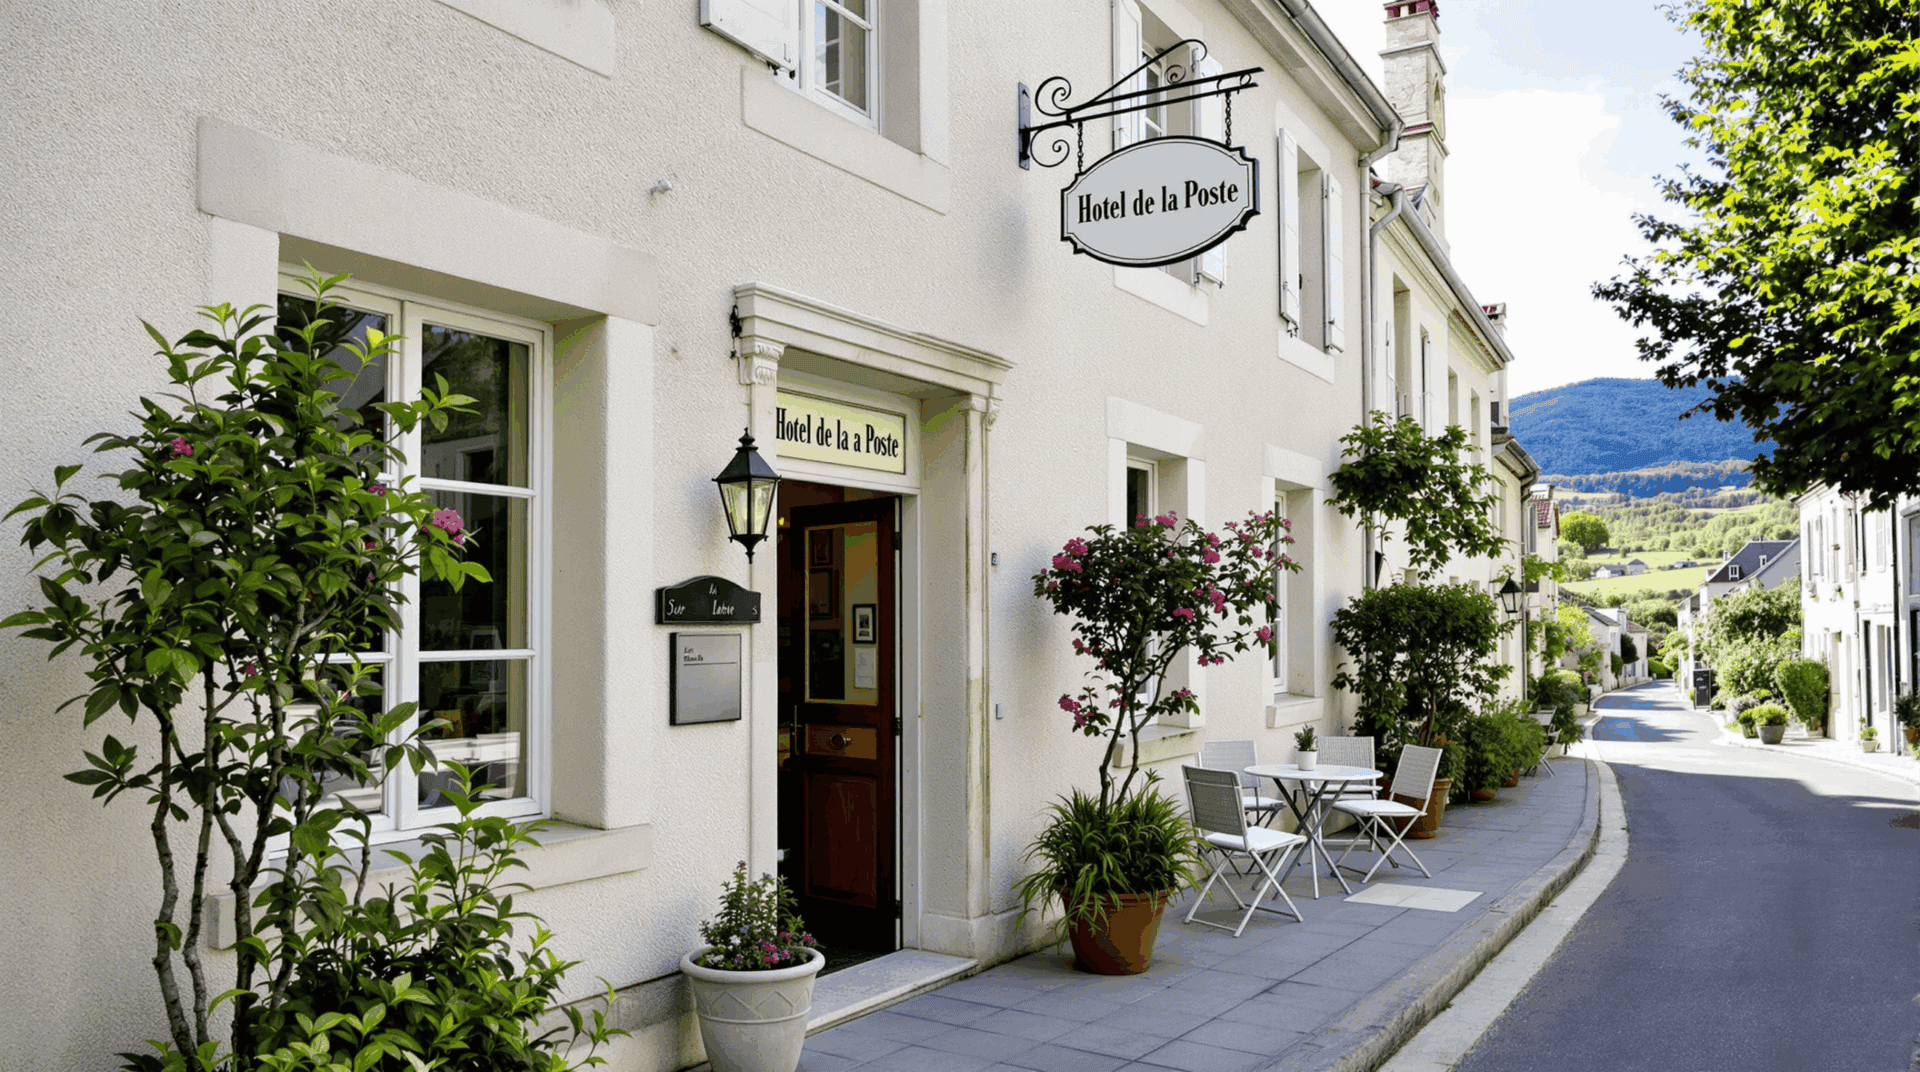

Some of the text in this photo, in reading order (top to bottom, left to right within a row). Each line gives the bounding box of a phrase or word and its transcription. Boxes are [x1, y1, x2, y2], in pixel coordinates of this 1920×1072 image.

[1078, 180, 1239, 224] Hotel de la Poste
[776, 407, 899, 458] Hotel de la a Poste
